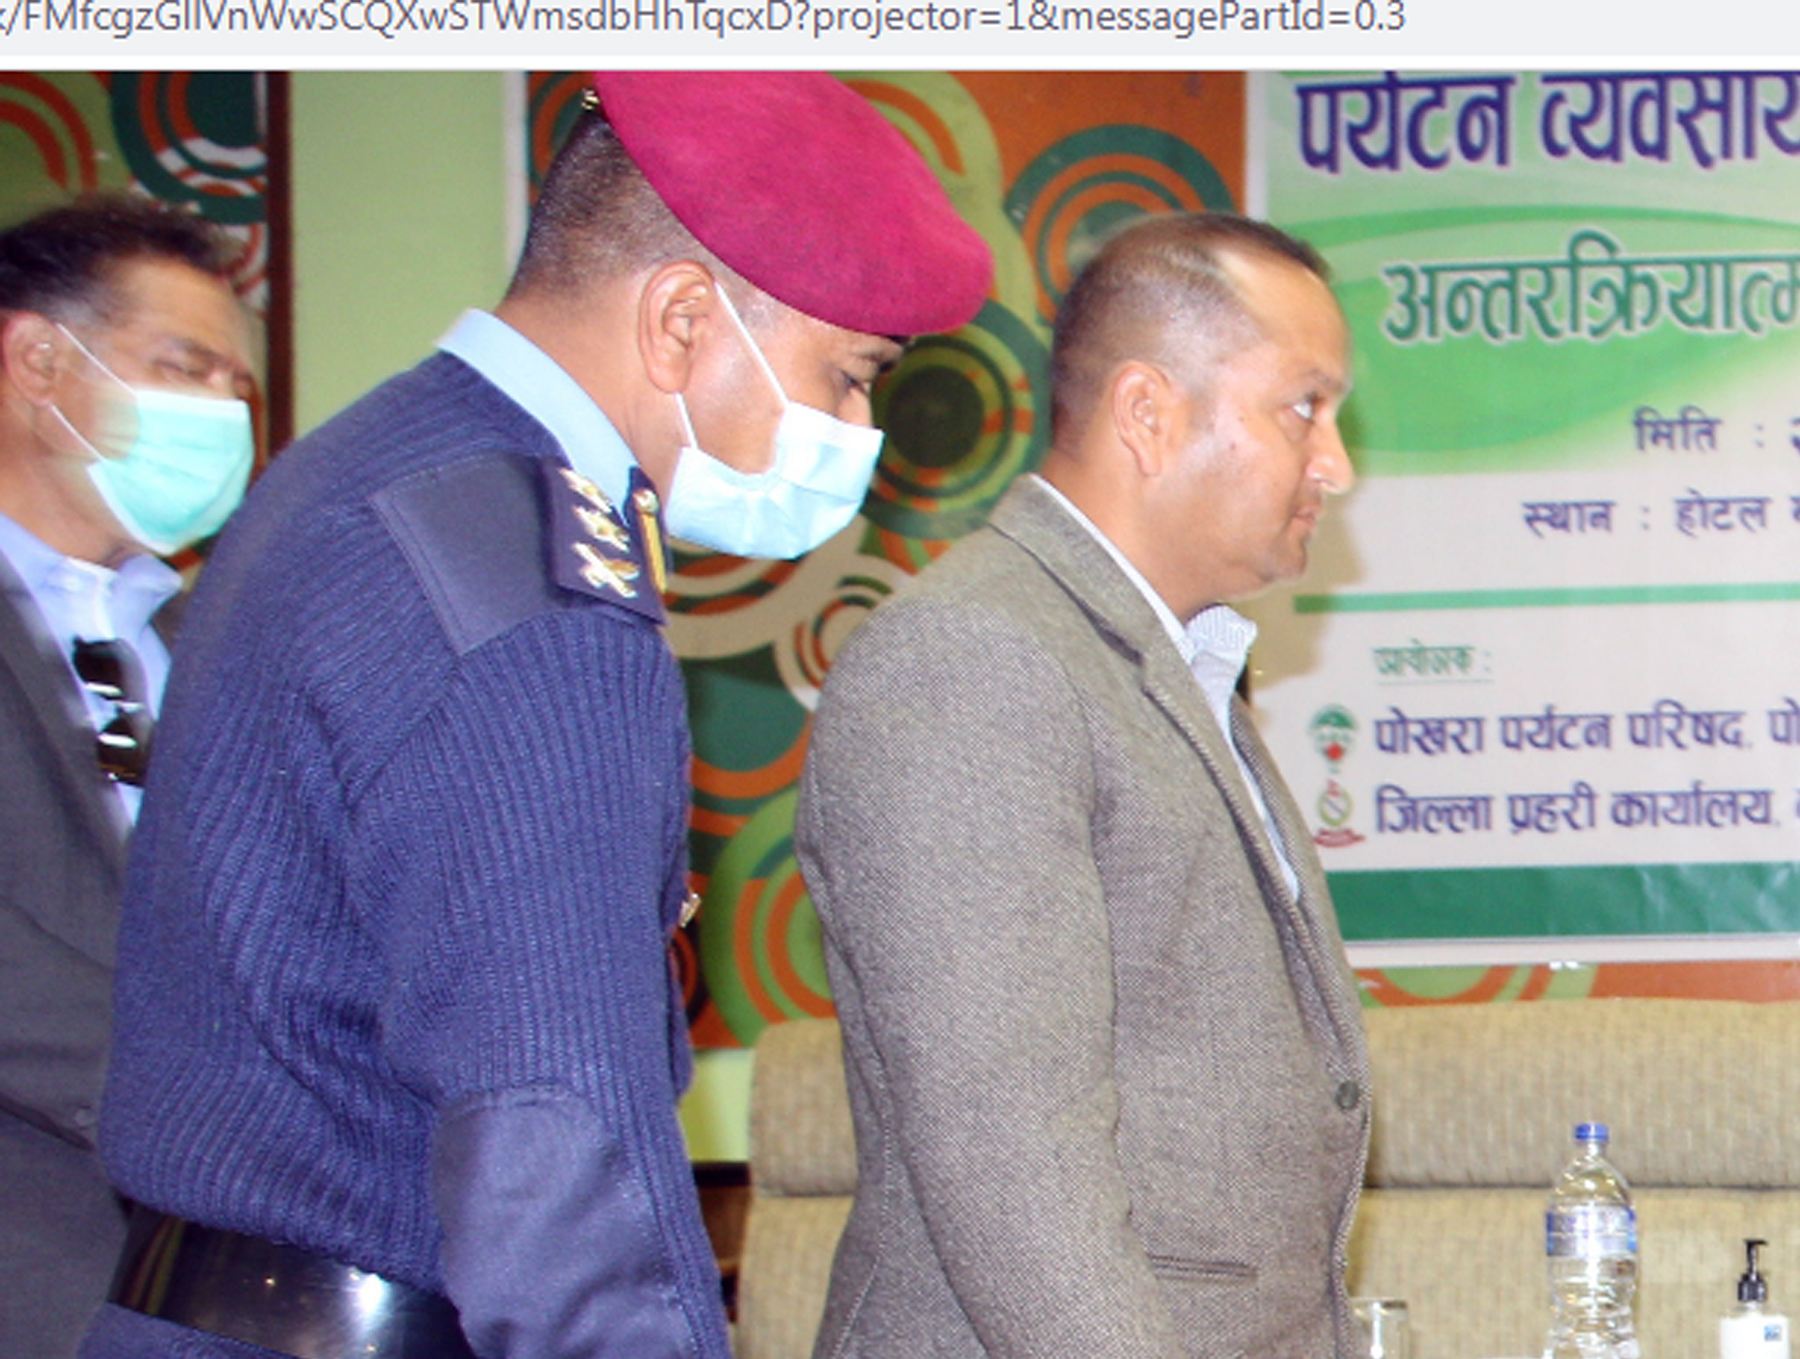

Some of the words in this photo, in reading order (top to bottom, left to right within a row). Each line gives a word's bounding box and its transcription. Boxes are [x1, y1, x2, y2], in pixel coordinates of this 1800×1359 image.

[1633, 406, 1723, 453] मिति
[1522, 500, 1616, 538] स्थान
[1674, 488, 1771, 538] होटल
[1374, 707, 1486, 755] पोखरा
[1499, 703, 1614, 750] पर्यटन
[1374, 784, 1495, 834] जिल्ला
[1507, 781, 1599, 835] प्रहरी
